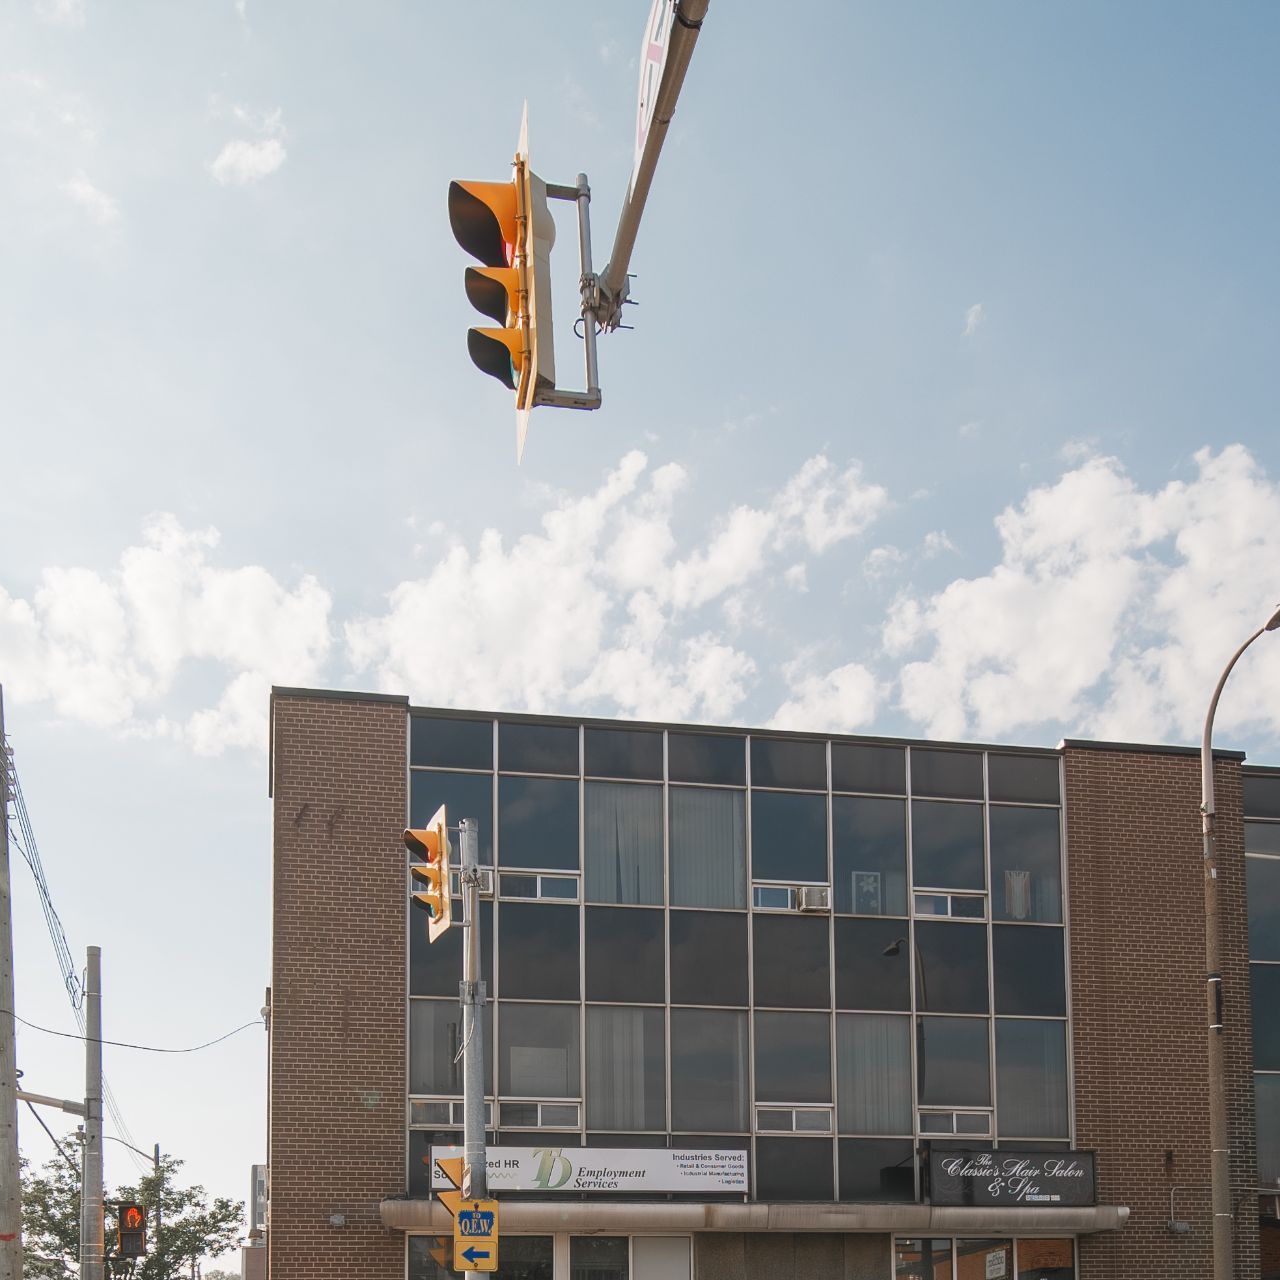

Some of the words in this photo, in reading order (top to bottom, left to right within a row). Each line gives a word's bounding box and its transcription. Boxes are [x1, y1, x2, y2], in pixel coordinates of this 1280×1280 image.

[504, 1160, 520, 1168] HR
[975, 1153, 992, 1166] The
[578, 1167, 646, 1179] Employment
[941, 1158, 999, 1177] Classic's
[1001, 1159, 1041, 1177] Hair
[1043, 1159, 1085, 1177] Salon
[574, 1178, 619, 1189] Services
[987, 1177, 1005, 1197] &
[1007, 1176, 1041, 1200] Spa
[461, 1218, 491, 1236] Q.E.W.
